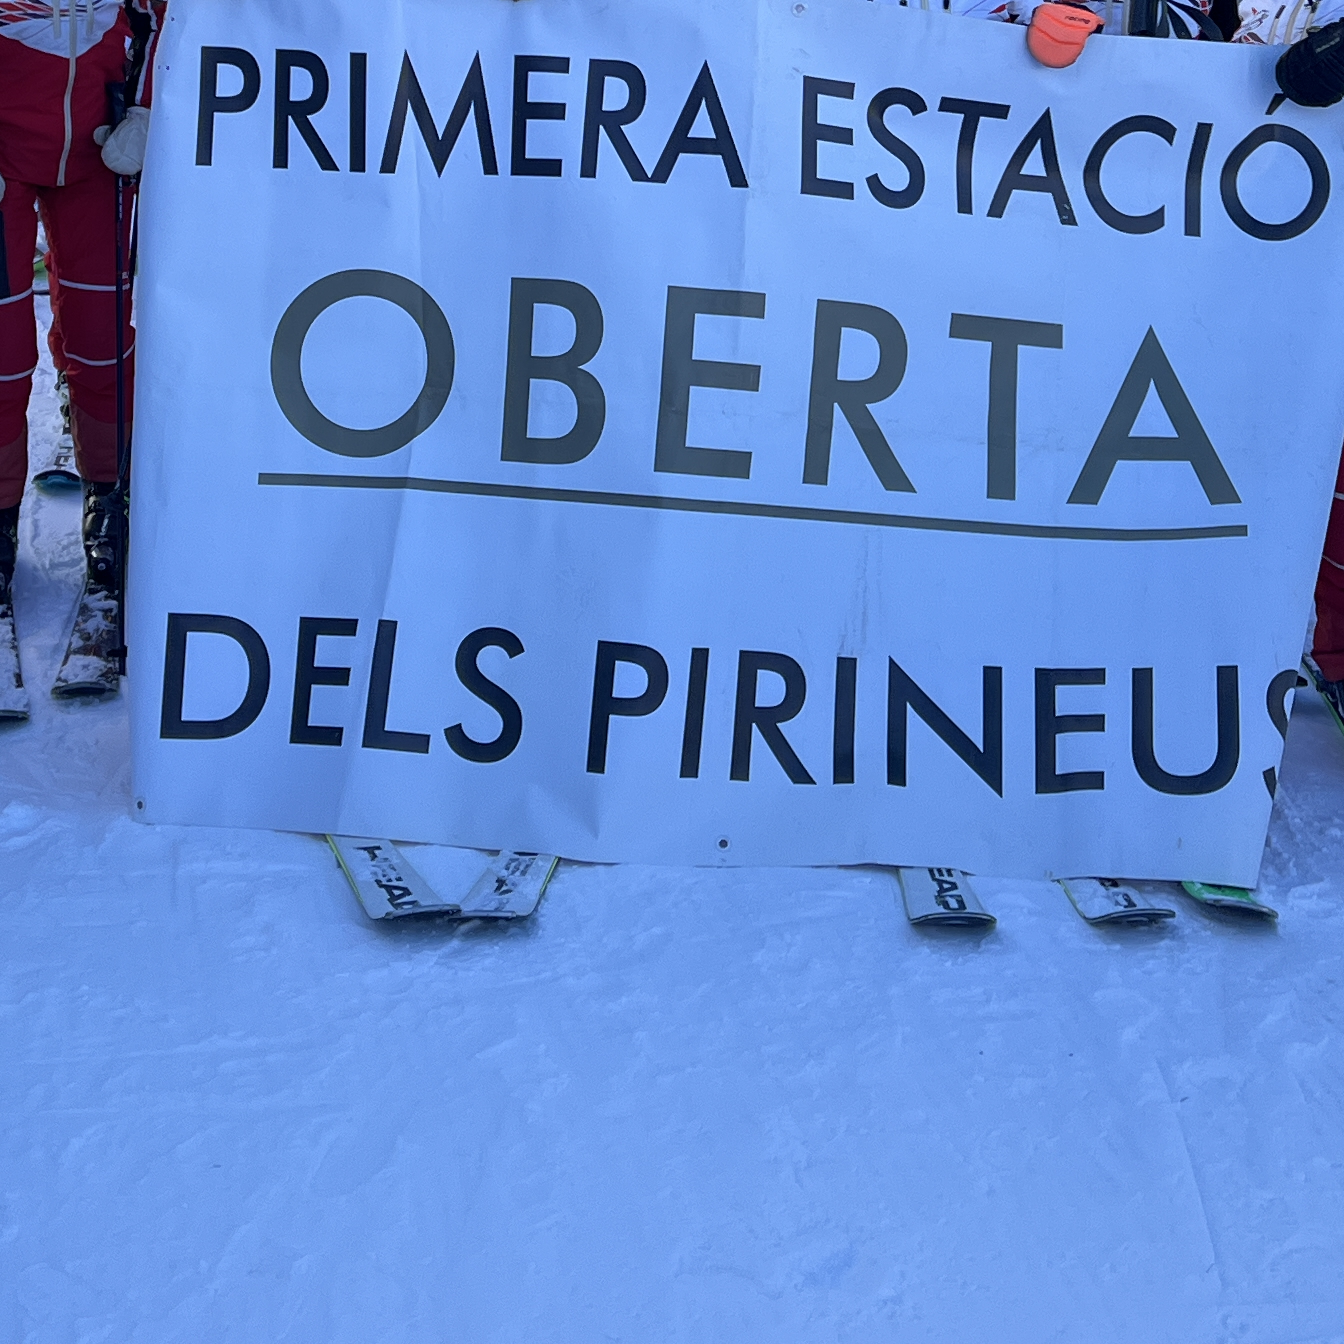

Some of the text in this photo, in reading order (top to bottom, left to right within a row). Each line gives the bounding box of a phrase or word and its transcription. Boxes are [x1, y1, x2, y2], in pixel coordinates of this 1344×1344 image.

[195, 45, 1331, 242] PRIMERA ESTACIÓ
[269, 268, 1243, 506] OBERTA
[159, 612, 525, 764] DELS
[927, 867, 968, 912] EAD
